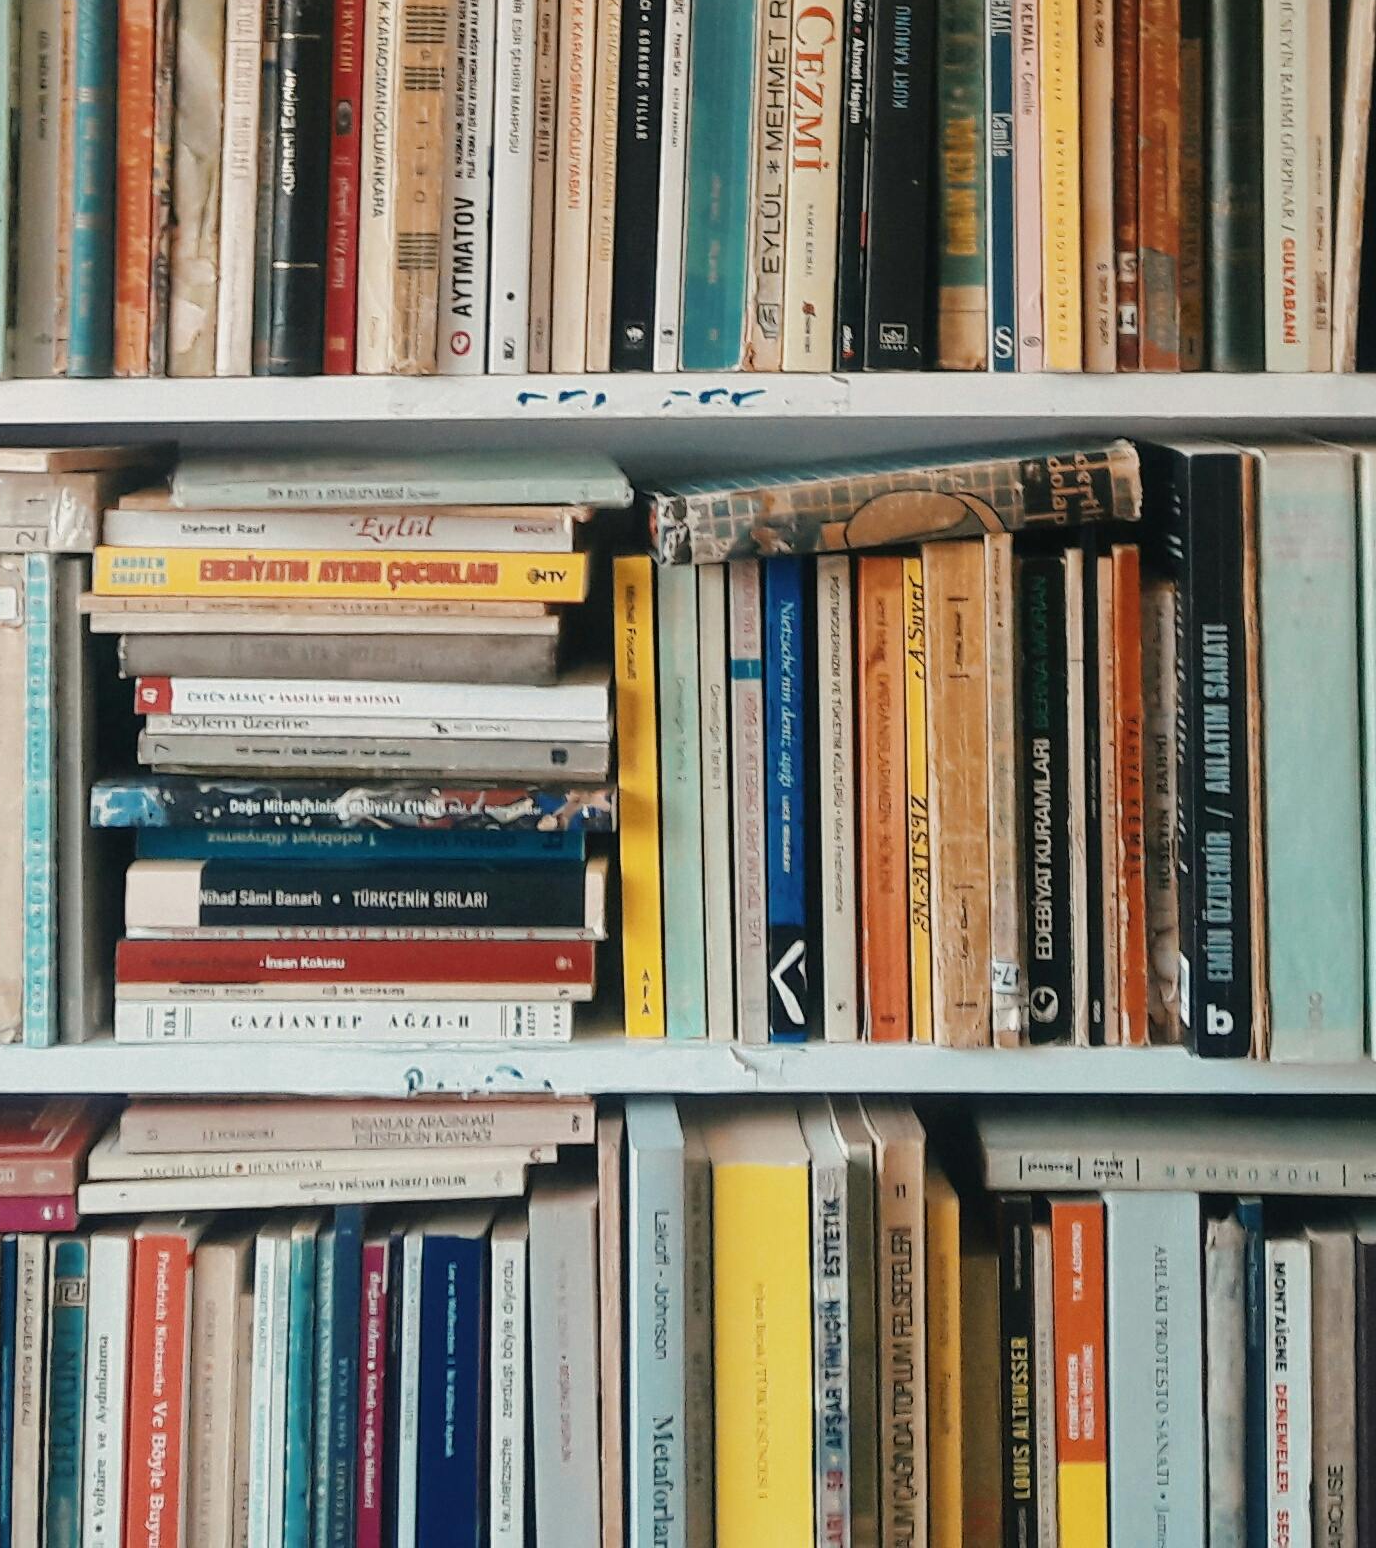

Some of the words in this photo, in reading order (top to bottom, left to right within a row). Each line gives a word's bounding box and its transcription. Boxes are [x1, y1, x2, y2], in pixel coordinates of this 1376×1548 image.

[1021, 3, 1036, 56] KEMAL
[763, 30, 786, 152] MEHMET
[451, 196, 475, 318] AYTMATOV
[759, 183, 783, 274] EYLÜL
[1201, 623, 1231, 699] SANATI
[1203, 703, 1232, 794] ANLATIM
[1032, 737, 1052, 864] KURAMLARI
[351, 888, 431, 912] TÜRKÇENİN
[435, 890, 489, 909] SIRLARI
[1030, 864, 1054, 960] EDEBİYAT
[230, 1011, 364, 1032] GAZİANTEP
